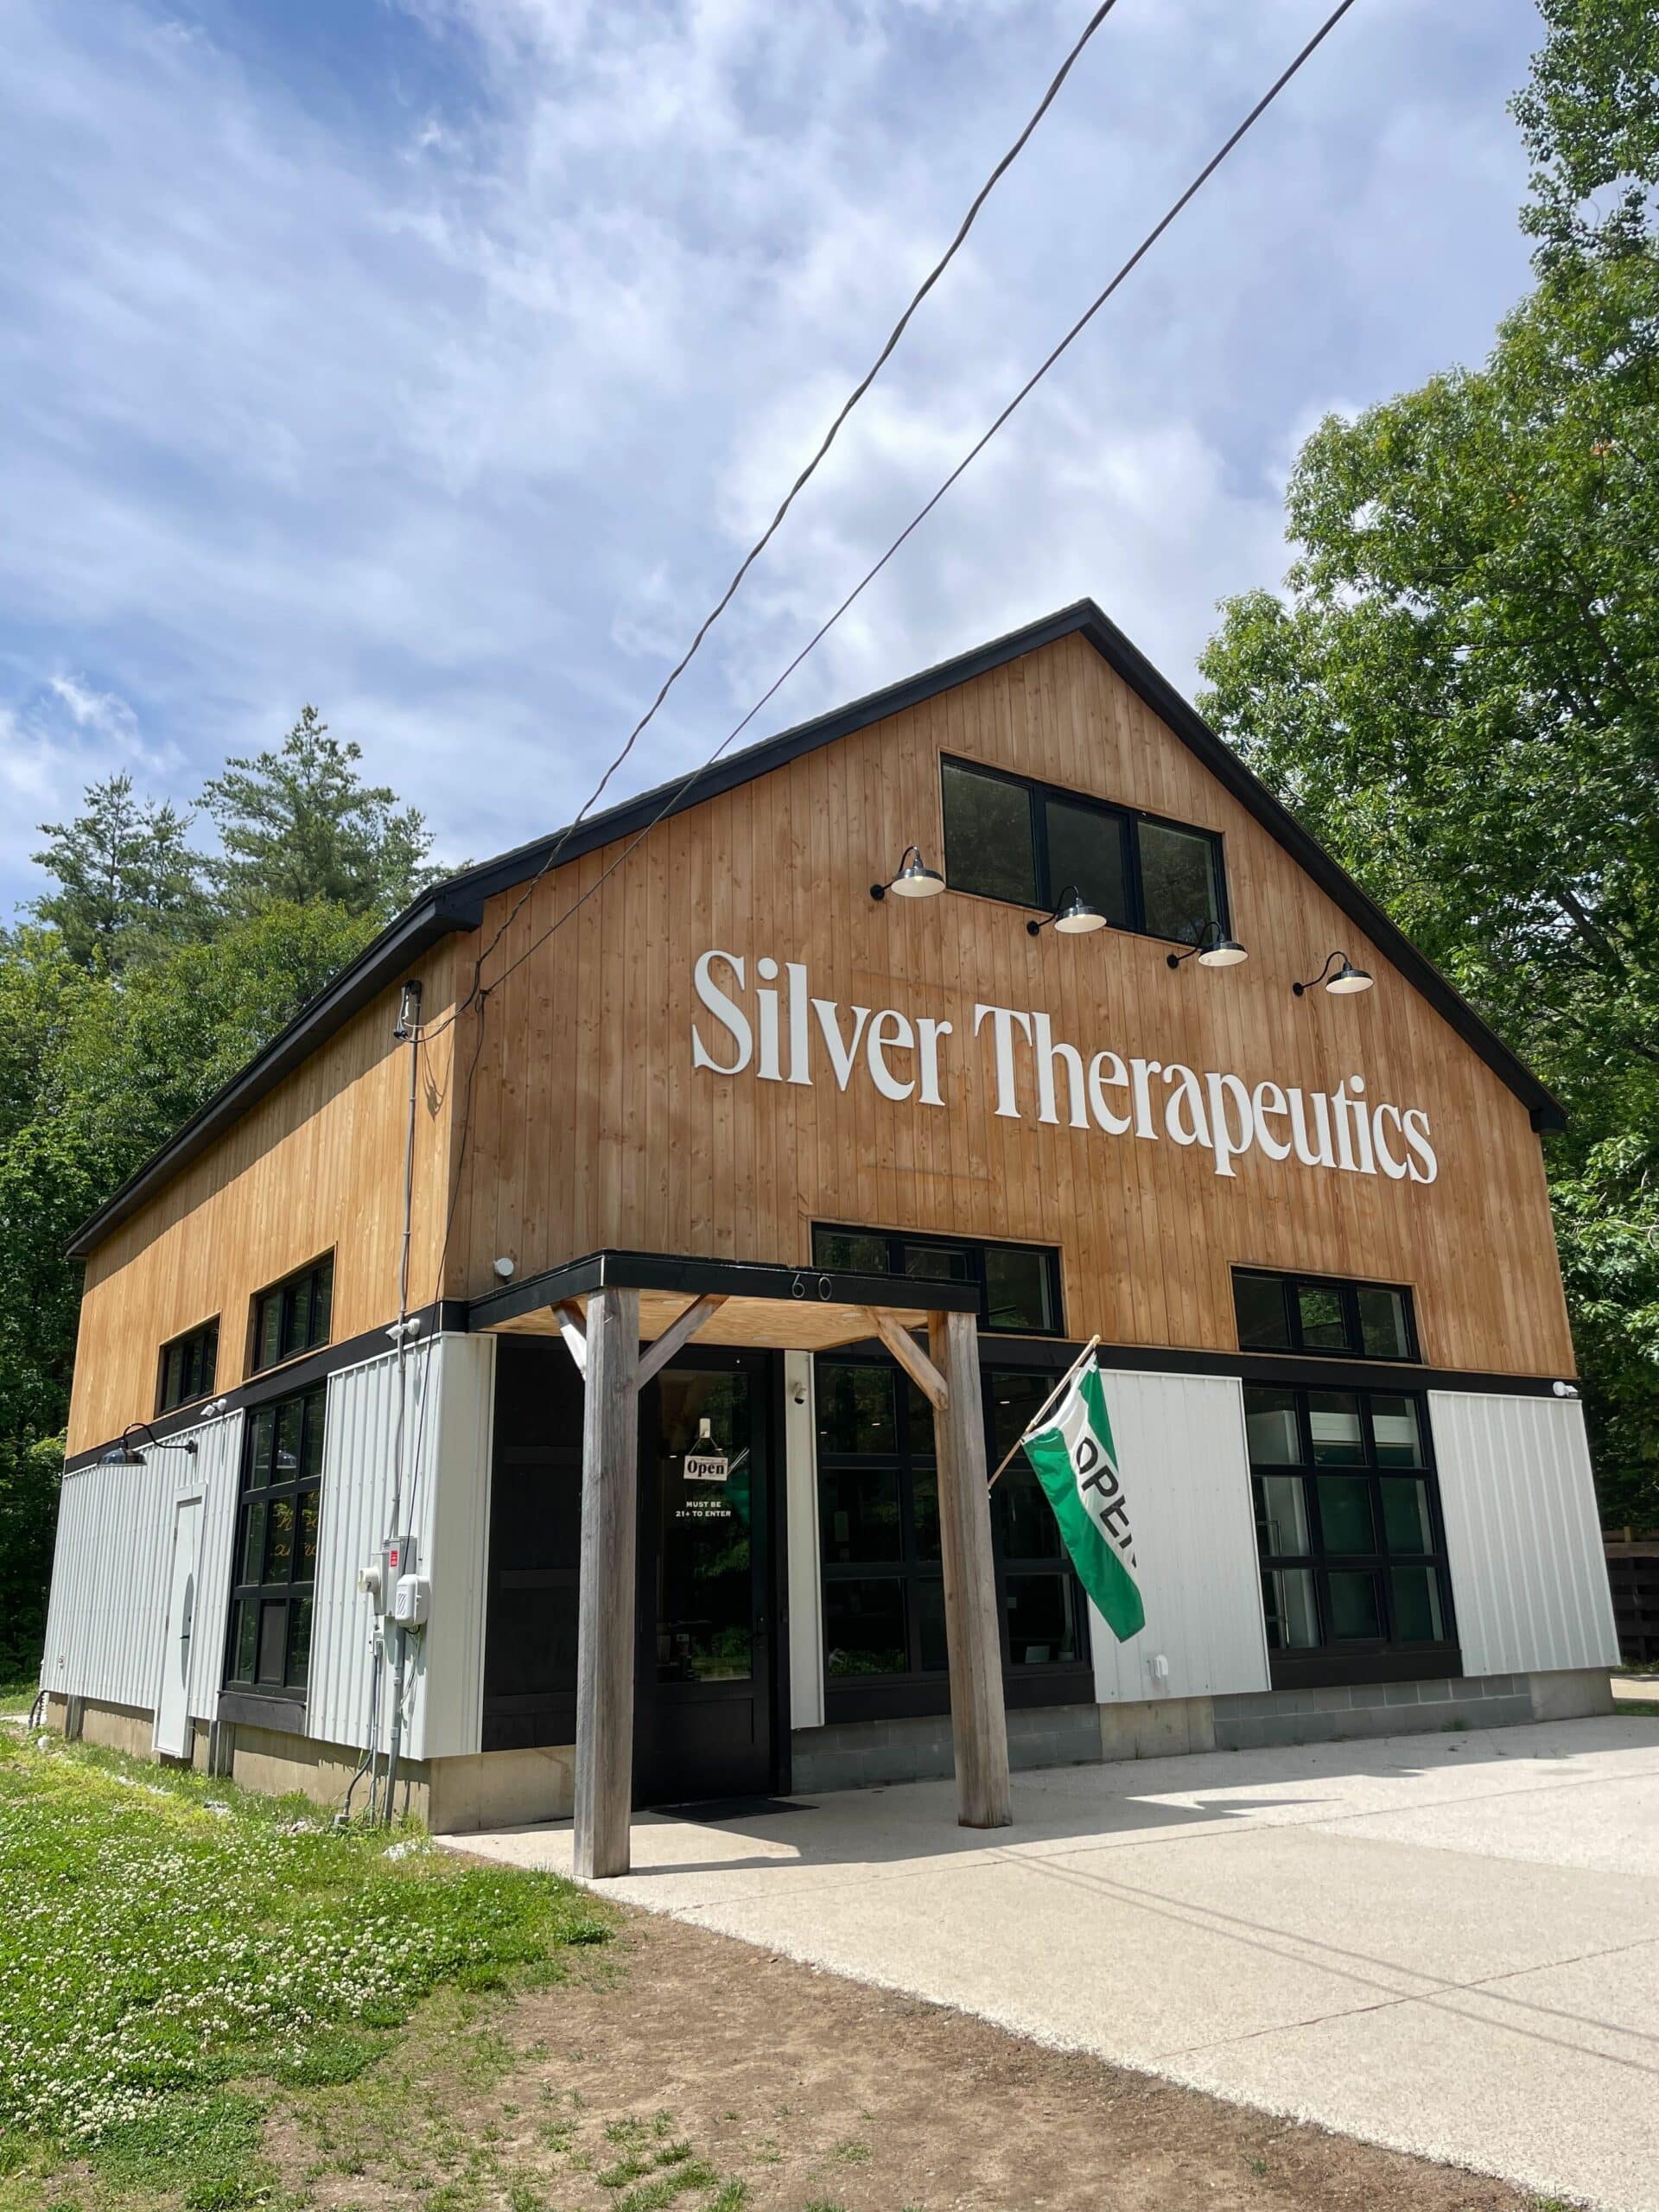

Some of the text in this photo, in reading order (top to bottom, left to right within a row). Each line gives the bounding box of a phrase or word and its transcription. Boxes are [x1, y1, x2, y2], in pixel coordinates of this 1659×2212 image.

[691, 950, 1438, 1185] Silver Therapeutics
[791, 1274, 832, 1300] 60
[687, 1459, 724, 1477] Open
